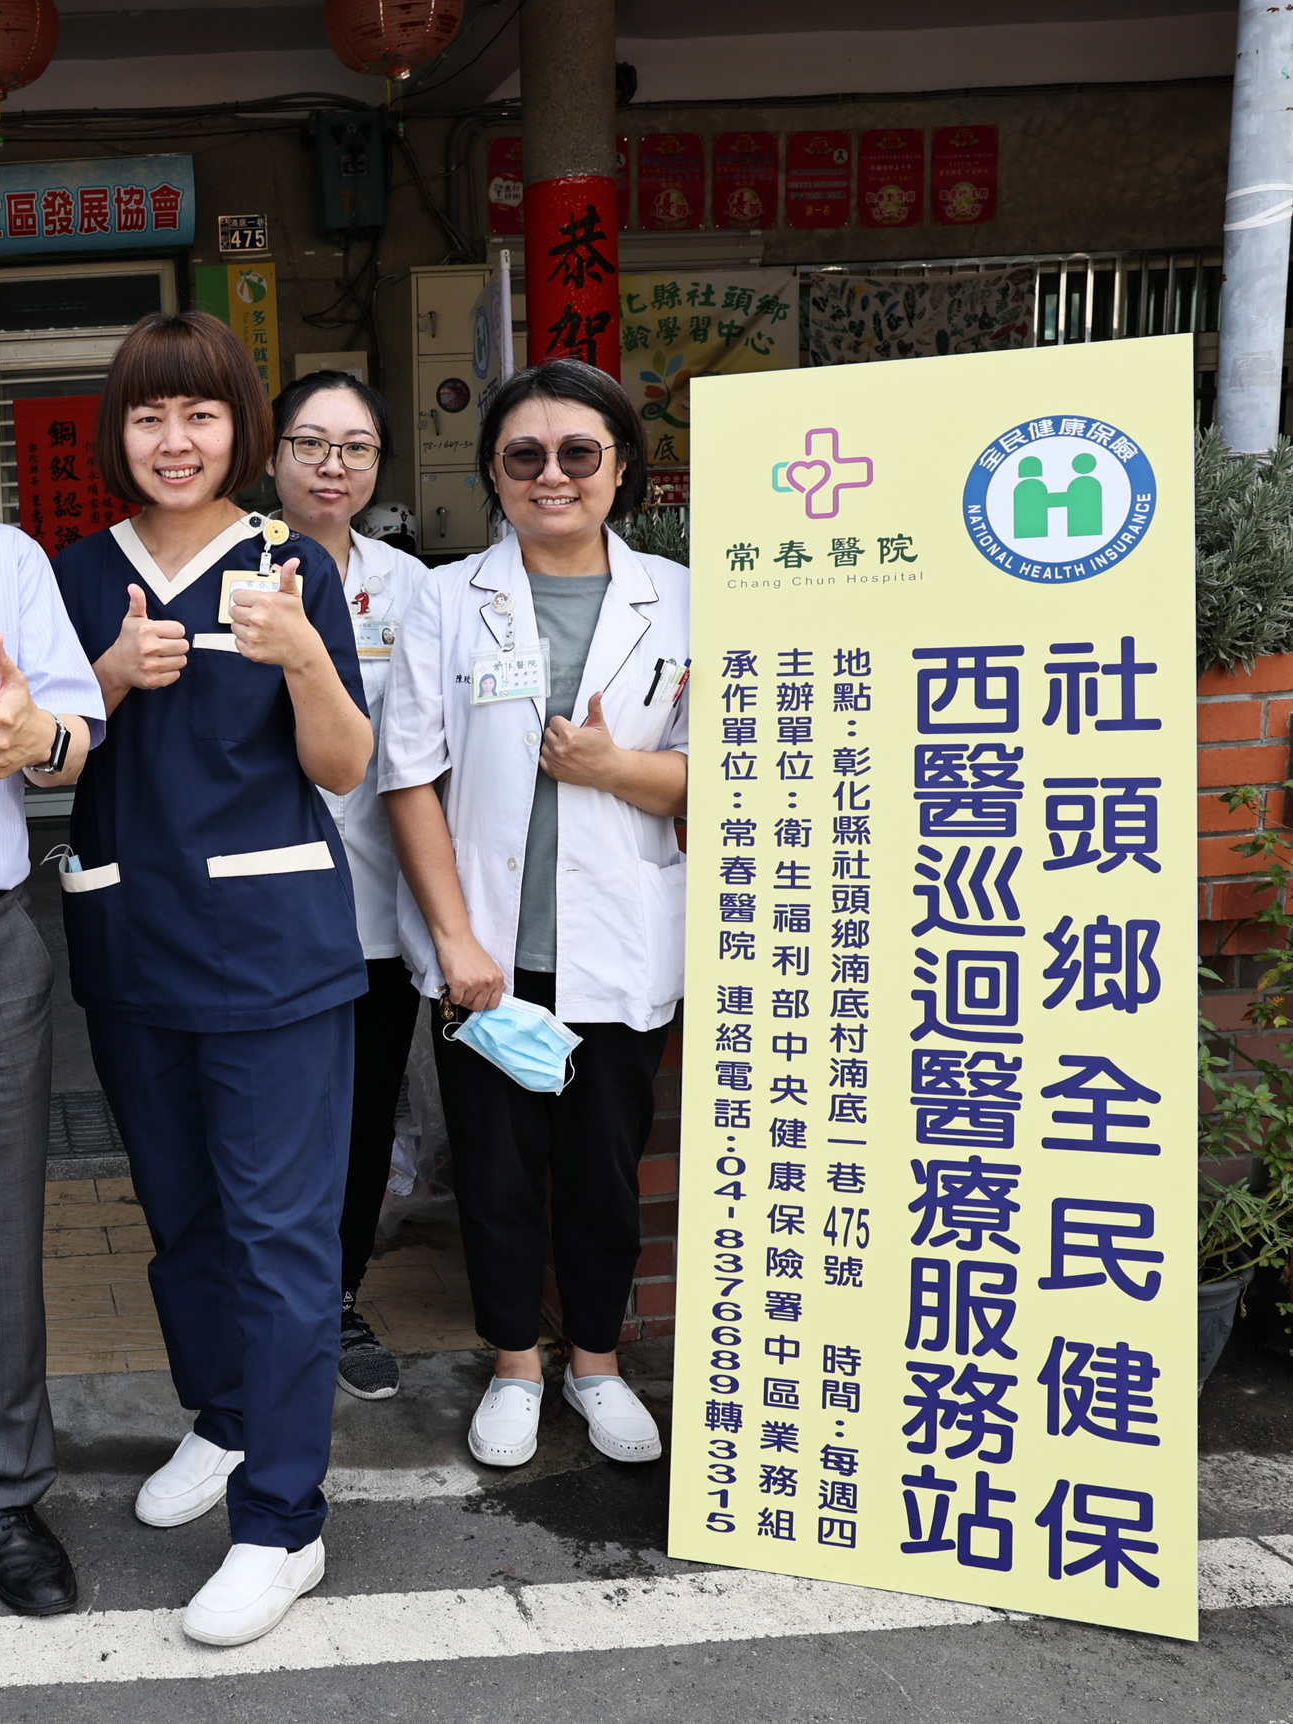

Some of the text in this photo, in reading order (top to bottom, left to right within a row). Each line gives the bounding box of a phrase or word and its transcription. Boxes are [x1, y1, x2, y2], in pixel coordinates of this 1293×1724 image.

[231, 229, 266, 248] 475
[545, 204, 616, 368] 恭賀
[48, 419, 84, 551] 銅級認證
[654, 435, 680, 462] 底
[978, 417, 1140, 472] 全民健康保險
[726, 533, 919, 572] 常春醫院
[727, 571, 924, 590] Chang Chun Hospital
[968, 492, 1152, 580] NATIONAL HEALTH INSURANCE
[718, 649, 759, 962] 承作單位：常春醫院
[756, 648, 815, 1542] 主辦單位：衛生福利部中央健康保險署中區業務組
[900, 645, 1026, 1572] 西醫巡迴醫療服務站
[1035, 636, 1164, 1589] 社頭鄉全民健保
